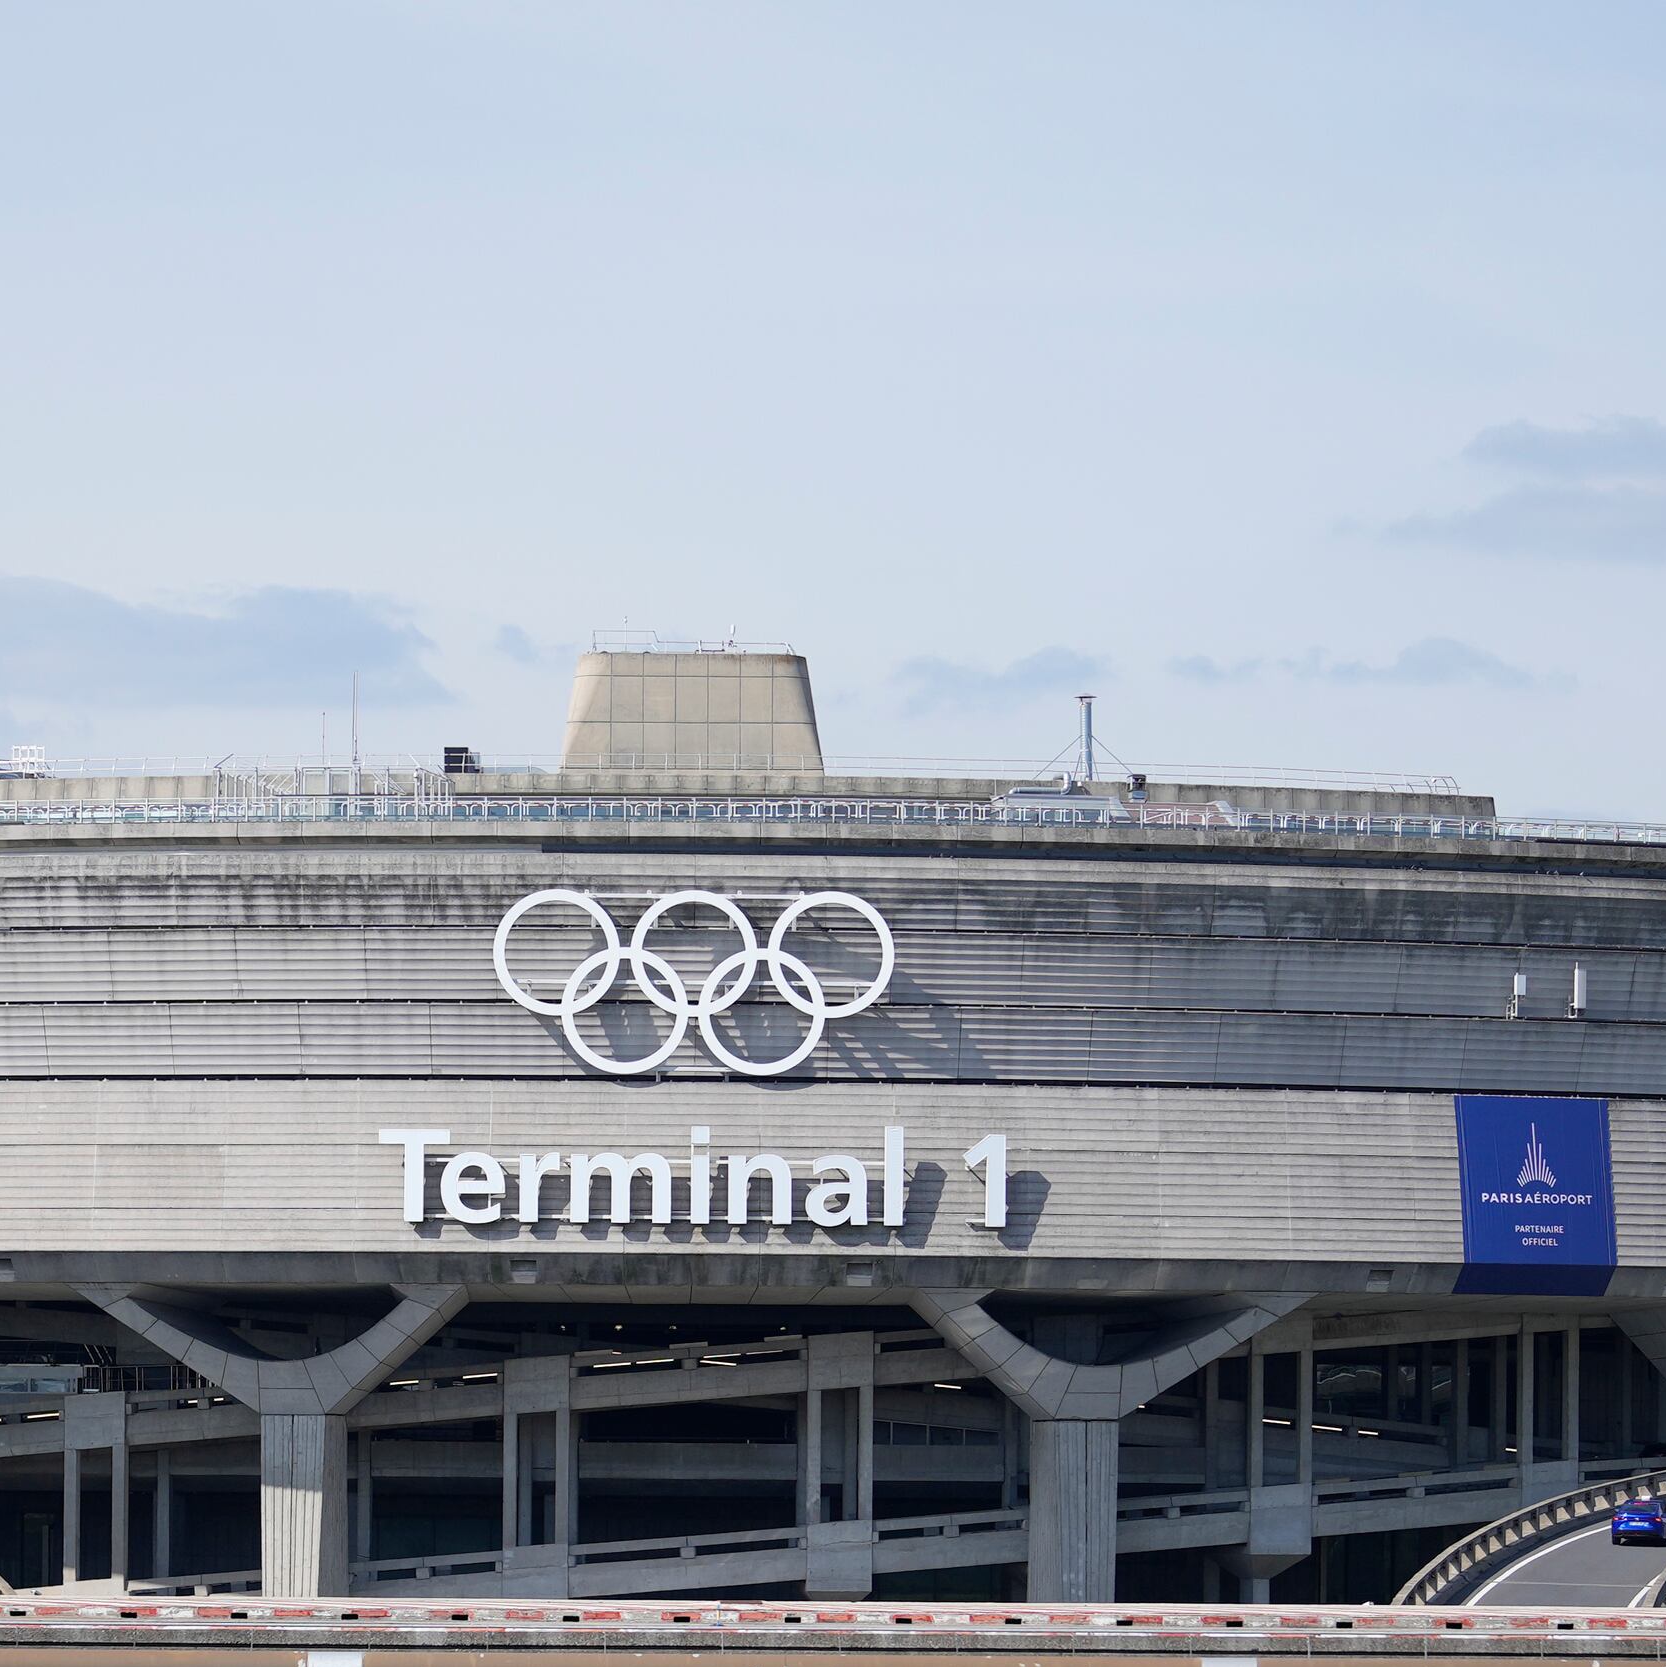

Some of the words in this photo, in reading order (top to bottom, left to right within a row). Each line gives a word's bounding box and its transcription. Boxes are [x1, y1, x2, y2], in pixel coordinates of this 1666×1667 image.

[379, 1126, 903, 1227] Terminal
[963, 1134, 1006, 1227] 1
[1515, 1225, 1564, 1234] PARTENAIRE
[1522, 1237, 1558, 1246] OFFICIEL
